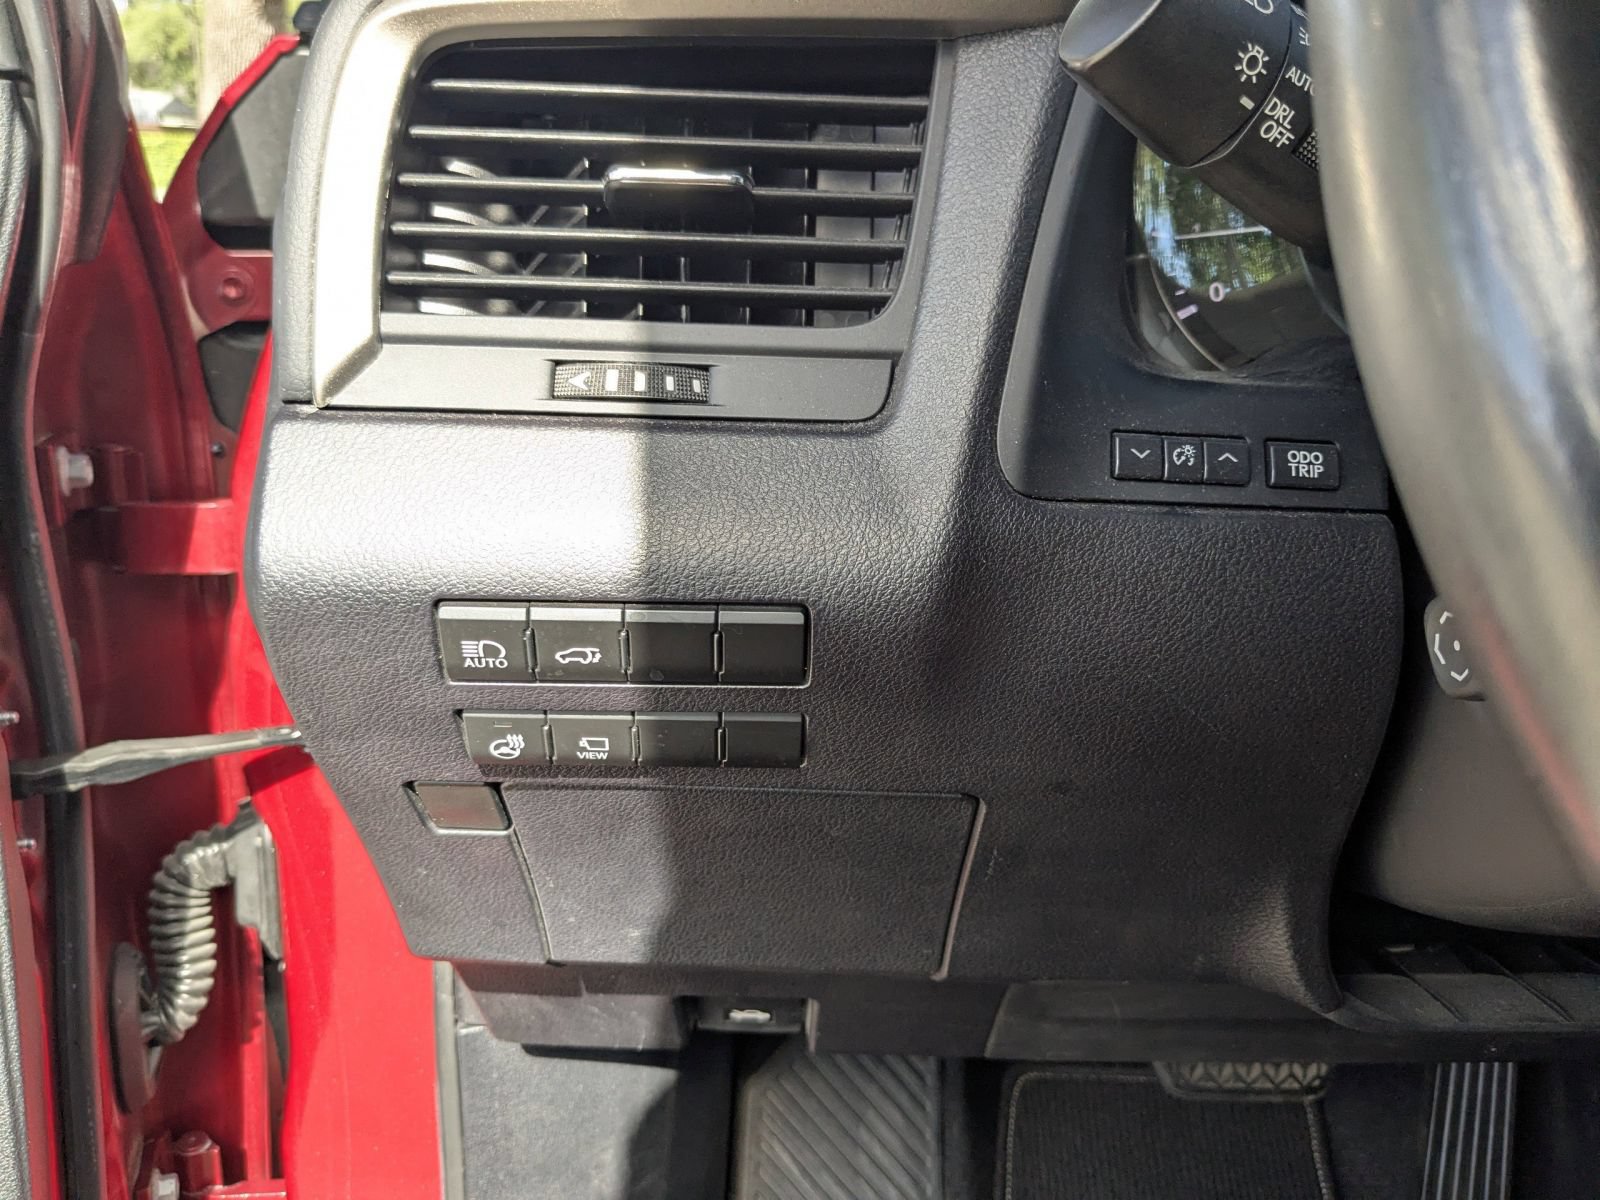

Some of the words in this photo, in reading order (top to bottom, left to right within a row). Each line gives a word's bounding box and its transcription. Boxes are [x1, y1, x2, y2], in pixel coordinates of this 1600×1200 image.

[1264, 98, 1295, 129] DRL
[1260, 121, 1295, 148] OFF
[1209, 282, 1225, 302] 0
[1287, 450, 1323, 464] ODO
[1288, 463, 1324, 478] TRIP
[463, 657, 508, 669] AUTO
[576, 751, 609, 760] VIEW
